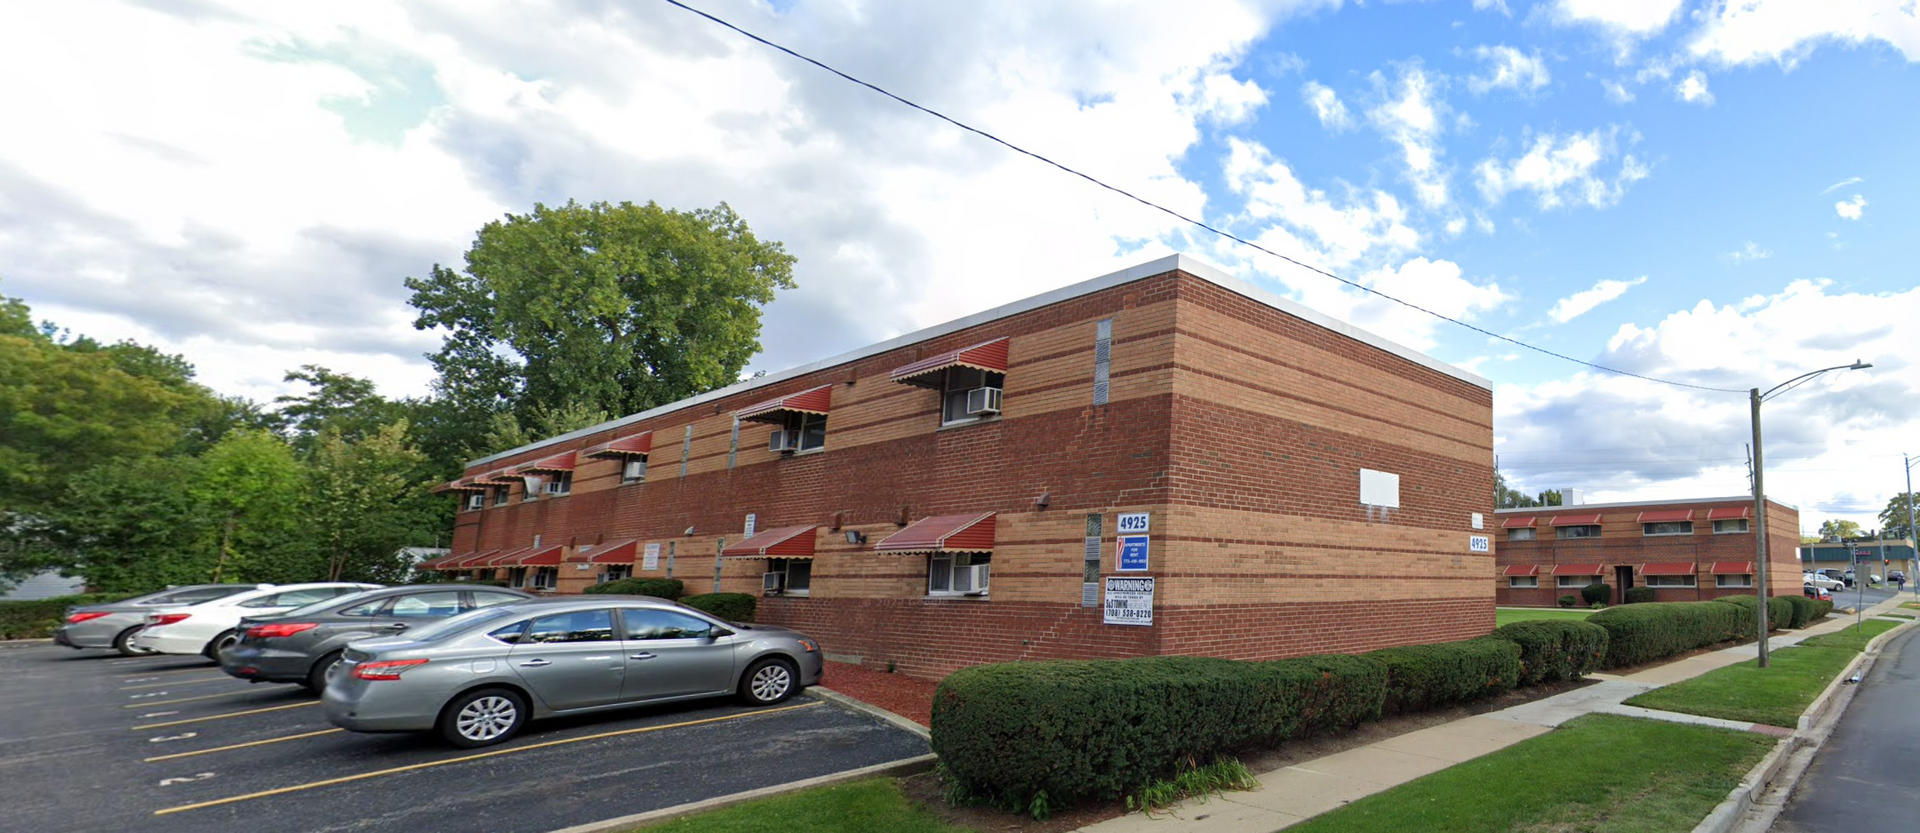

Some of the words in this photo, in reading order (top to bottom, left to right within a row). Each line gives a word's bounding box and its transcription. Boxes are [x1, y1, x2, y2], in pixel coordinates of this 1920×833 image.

[1120, 516, 1146, 530] 4925
[1472, 538, 1487, 550] 4925
[1114, 579, 1145, 591] WARNING
[1106, 609, 1121, 617] (708)
